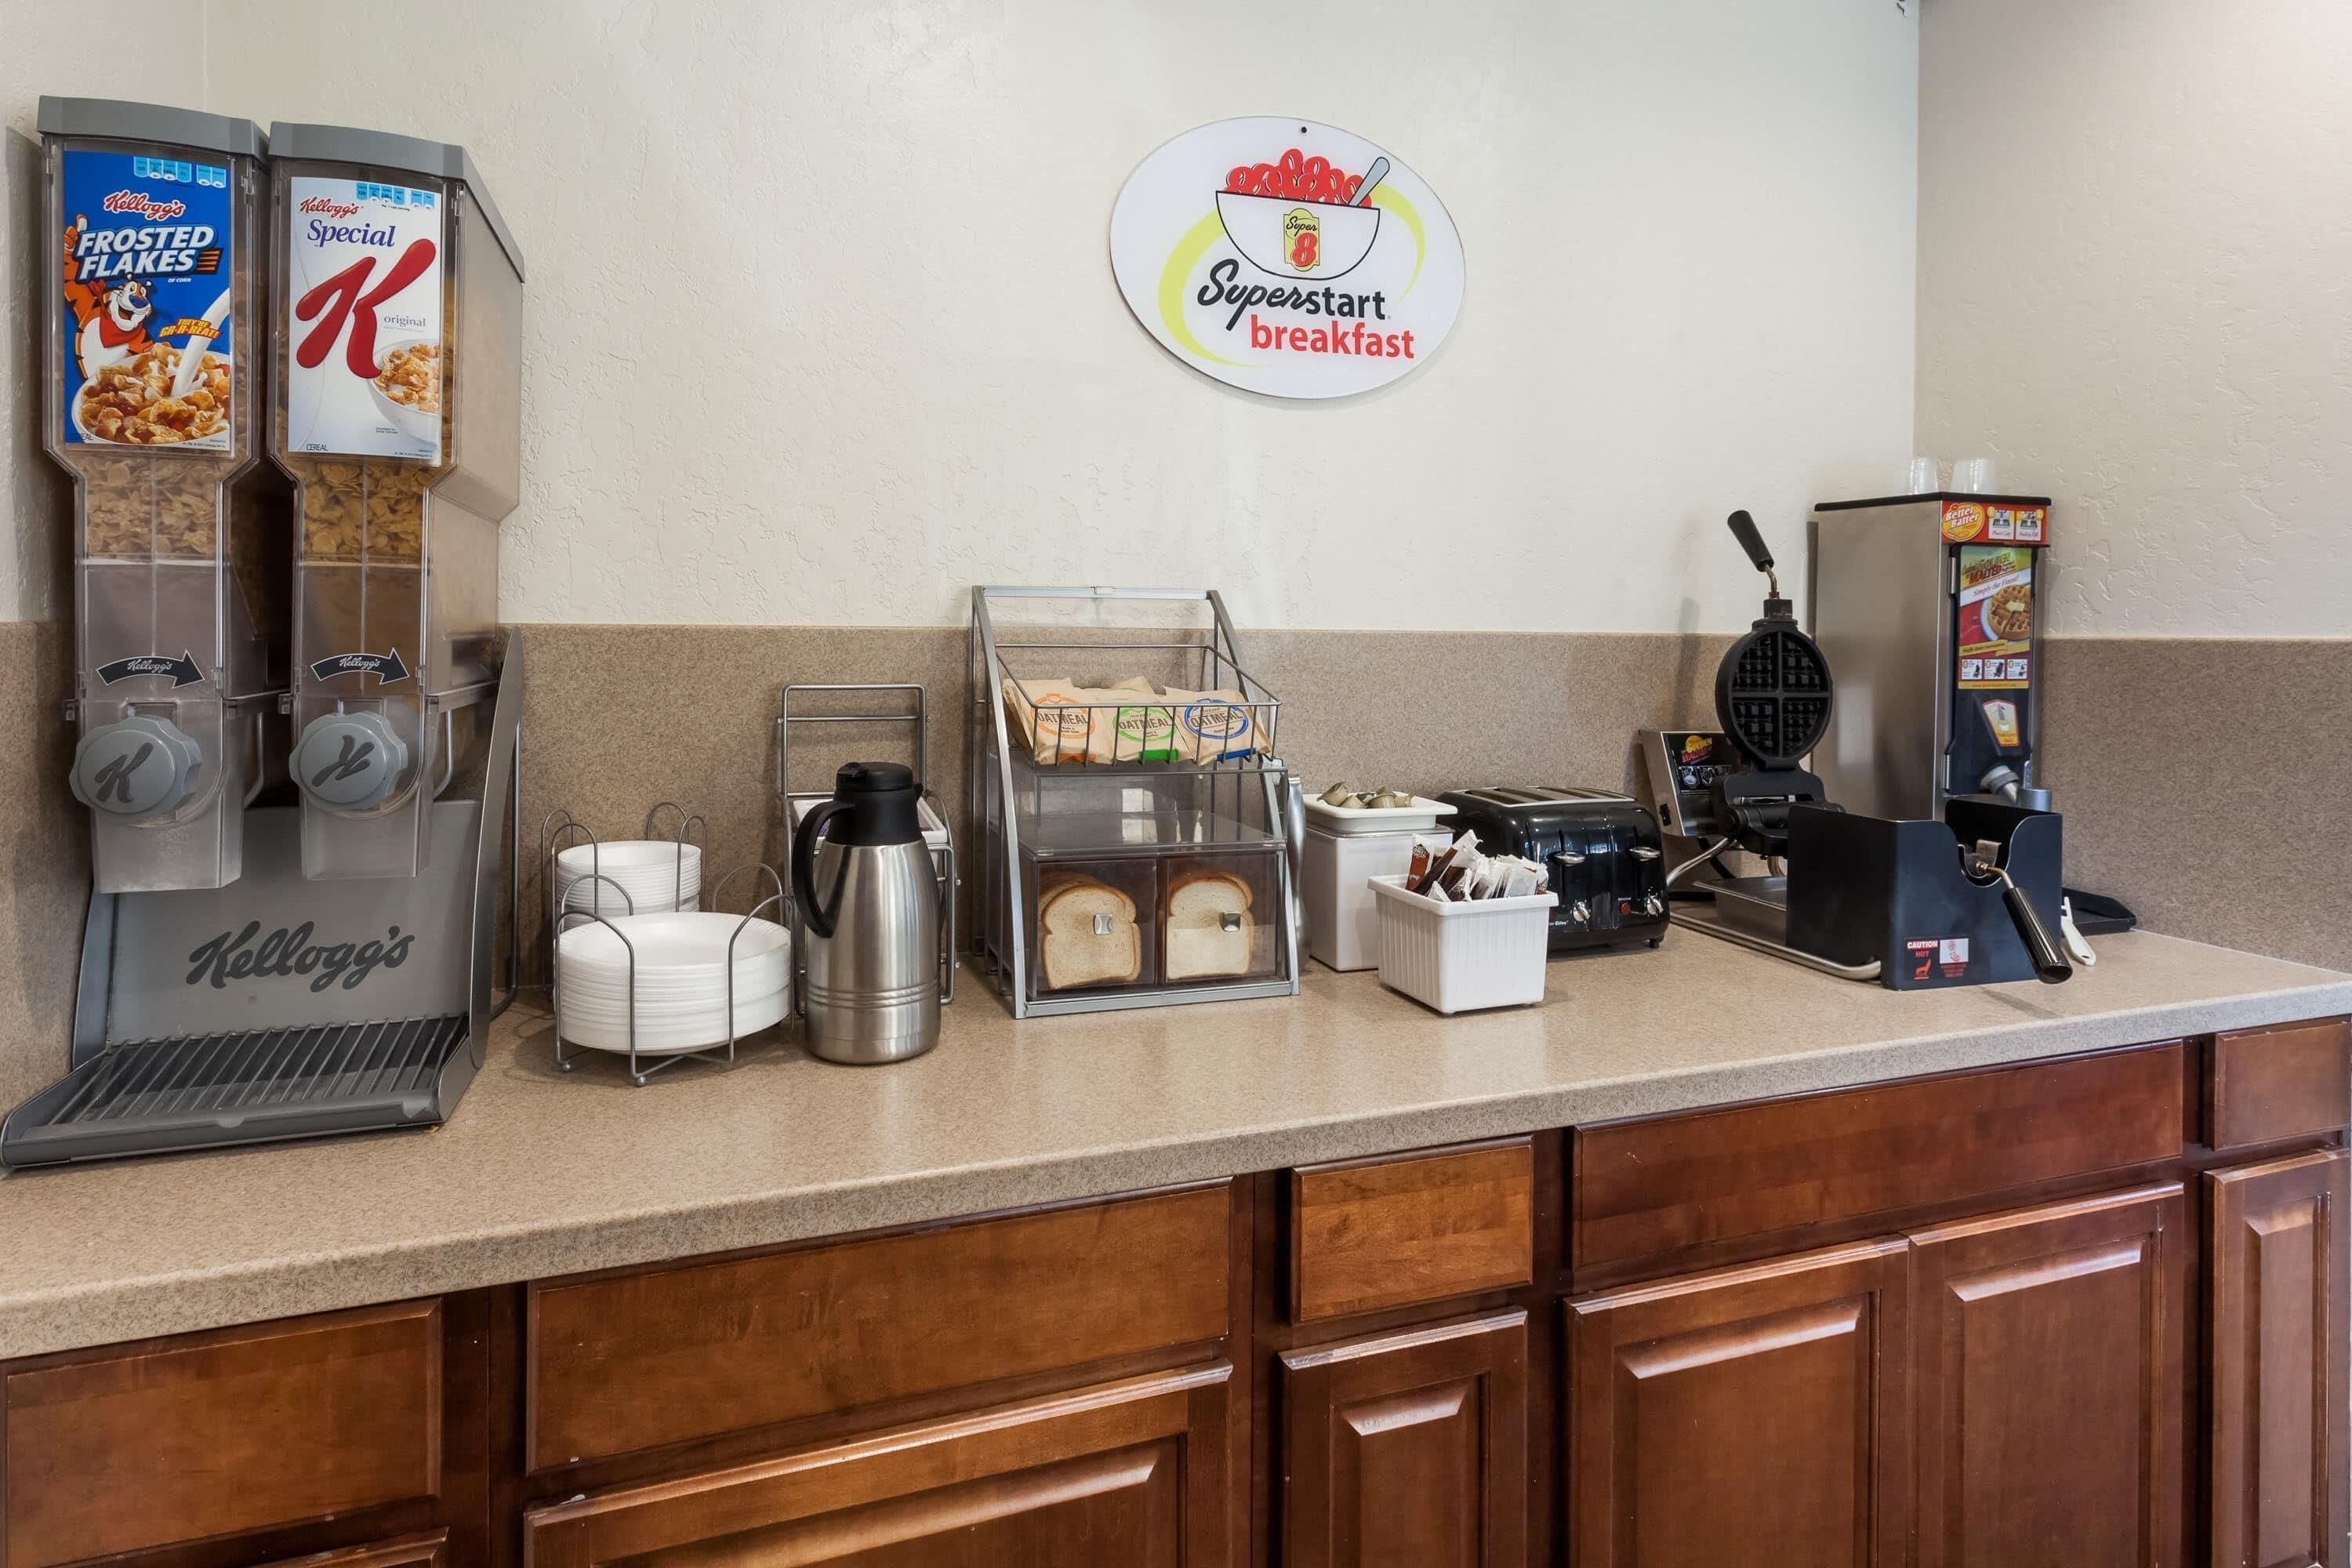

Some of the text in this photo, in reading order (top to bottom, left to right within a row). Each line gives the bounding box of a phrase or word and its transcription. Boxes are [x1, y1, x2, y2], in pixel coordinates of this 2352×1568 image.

[104, 190, 186, 220] Kellogg's
[300, 197, 360, 218] Kellogg's
[307, 220, 396, 247] Special
[1286, 216, 1318, 237] Super
[76, 226, 214, 257] FROSTED
[1290, 232, 1318, 267] 8
[79, 249, 197, 280] FLAKES
[296, 238, 437, 379] K
[383, 314, 426, 327] original
[1250, 314, 1415, 359] breakfast
[1946, 506, 1974, 521] Better
[1951, 514, 1980, 528] Batter
[127, 659, 174, 672] Kellogg's
[339, 656, 382, 670] Kellogg's
[1190, 710, 1243, 728] OATMEAL
[1907, 940, 1938, 949] CAUTION
[186, 920, 416, 993] Kellogg's
